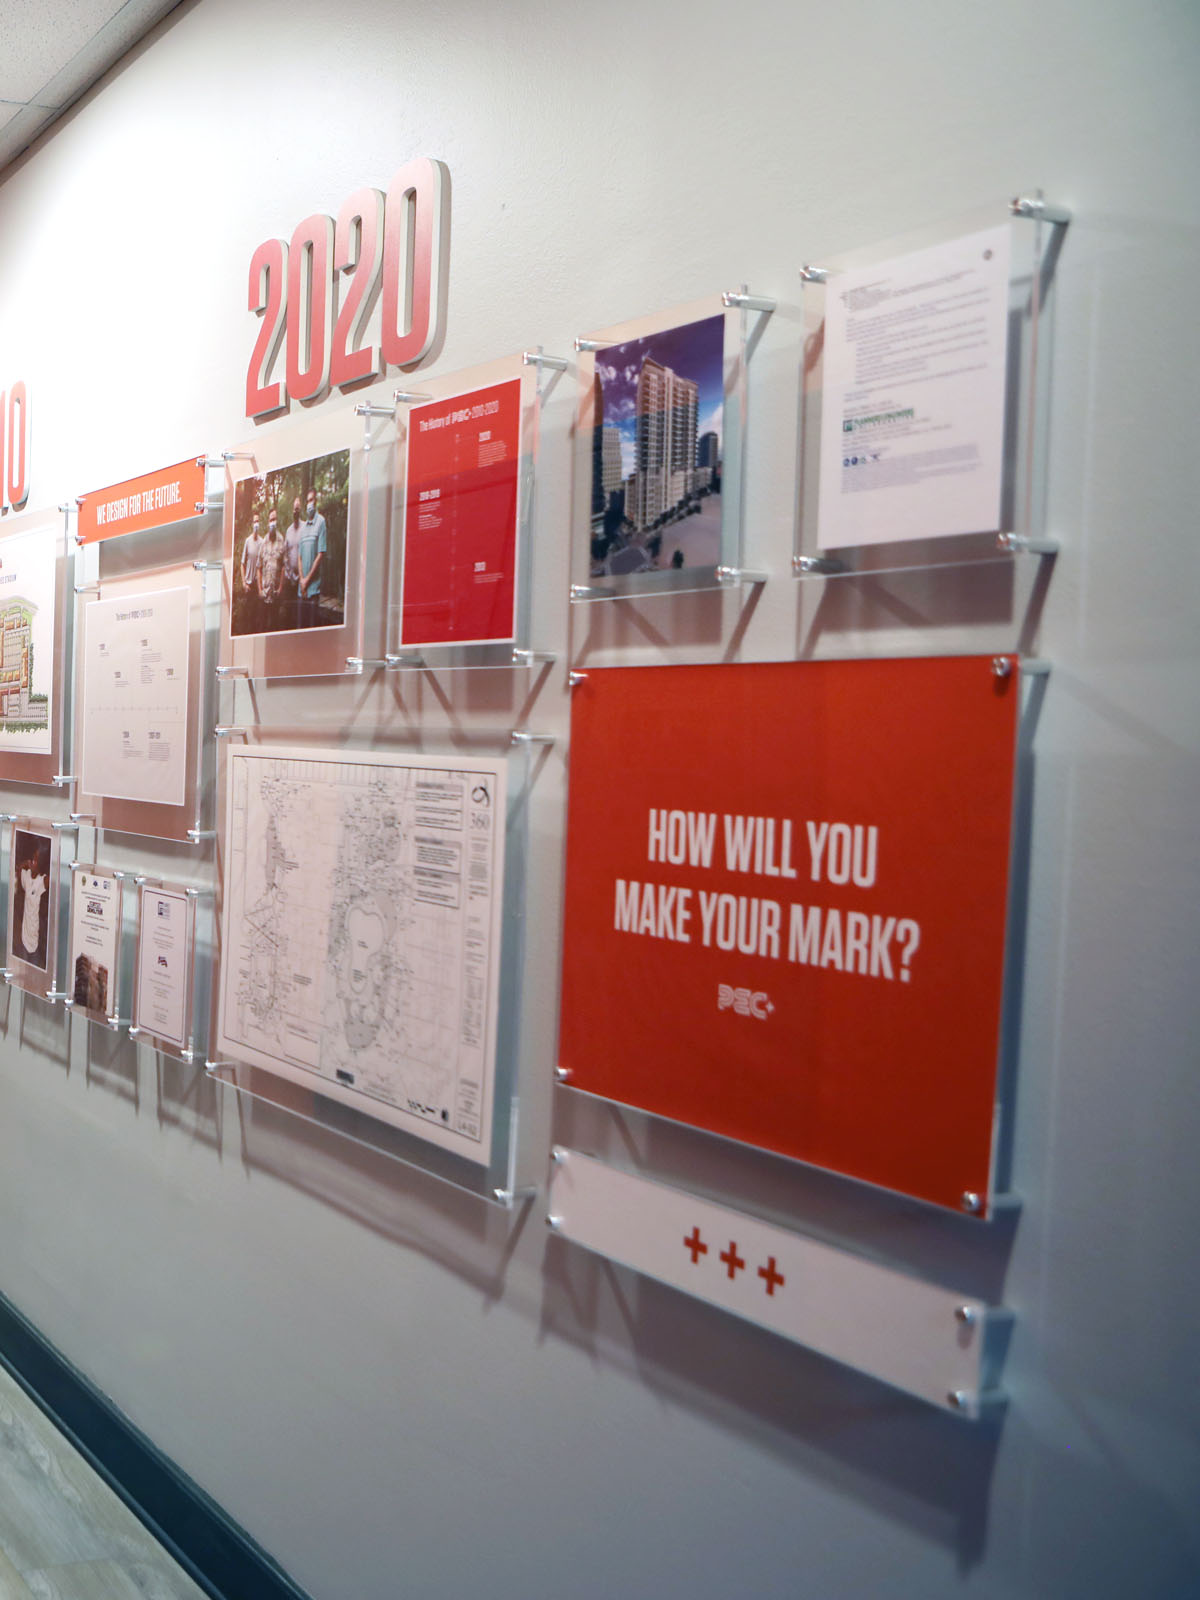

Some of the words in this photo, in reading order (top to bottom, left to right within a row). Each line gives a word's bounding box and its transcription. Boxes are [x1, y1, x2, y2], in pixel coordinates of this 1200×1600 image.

[246, 157, 442, 418] 2020
[96, 503, 106, 526] WE
[106, 496, 129, 523] DESIGN
[128, 493, 142, 517] FOR
[142, 489, 155, 513] THE
[154, 481, 182, 510] FUTURE.
[648, 808, 717, 869] HOW
[723, 814, 797, 879] WILL
[806, 820, 878, 888] YOU
[614, 879, 692, 943] MAKE
[698, 890, 781, 960] YOUR
[788, 903, 921, 984] MARK?
